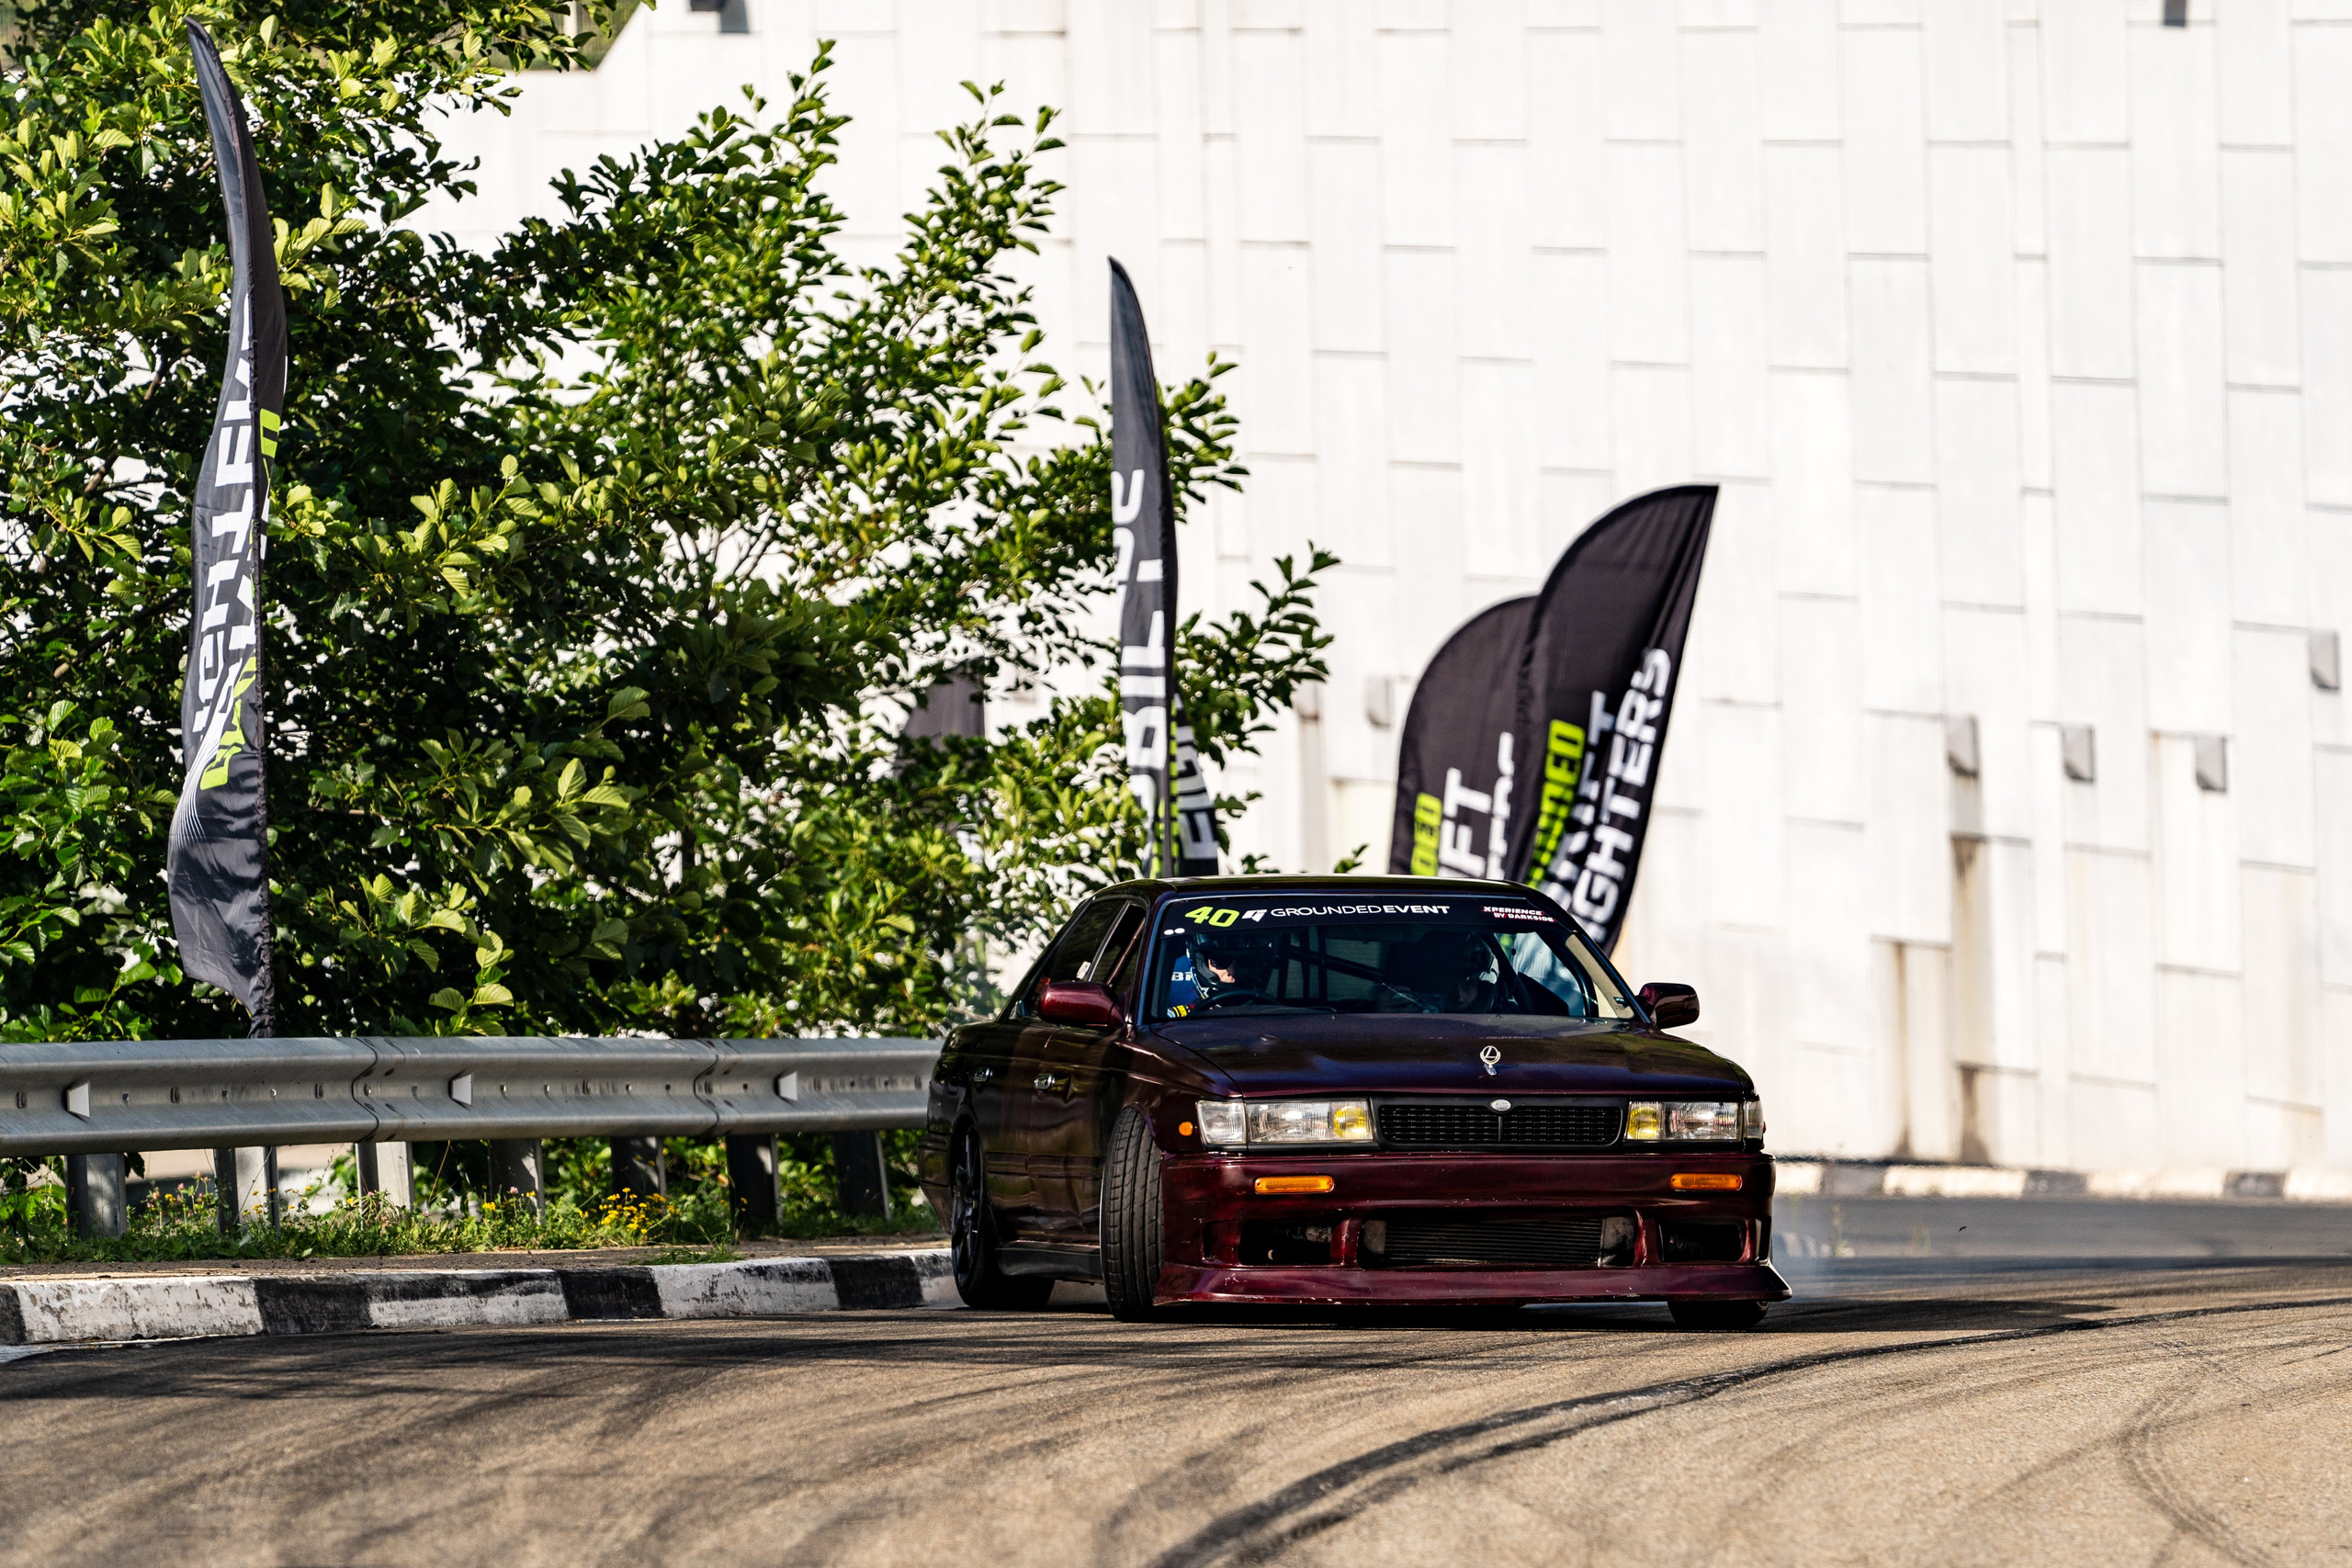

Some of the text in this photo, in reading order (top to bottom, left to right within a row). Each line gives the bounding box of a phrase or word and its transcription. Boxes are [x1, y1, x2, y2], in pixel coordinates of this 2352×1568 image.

[1572, 648, 1671, 944] IGHTERS
[1184, 906, 1240, 928] 40
[1483, 906, 1543, 916] XPERIENCE
[1508, 912, 1555, 922] DARKSIDE
